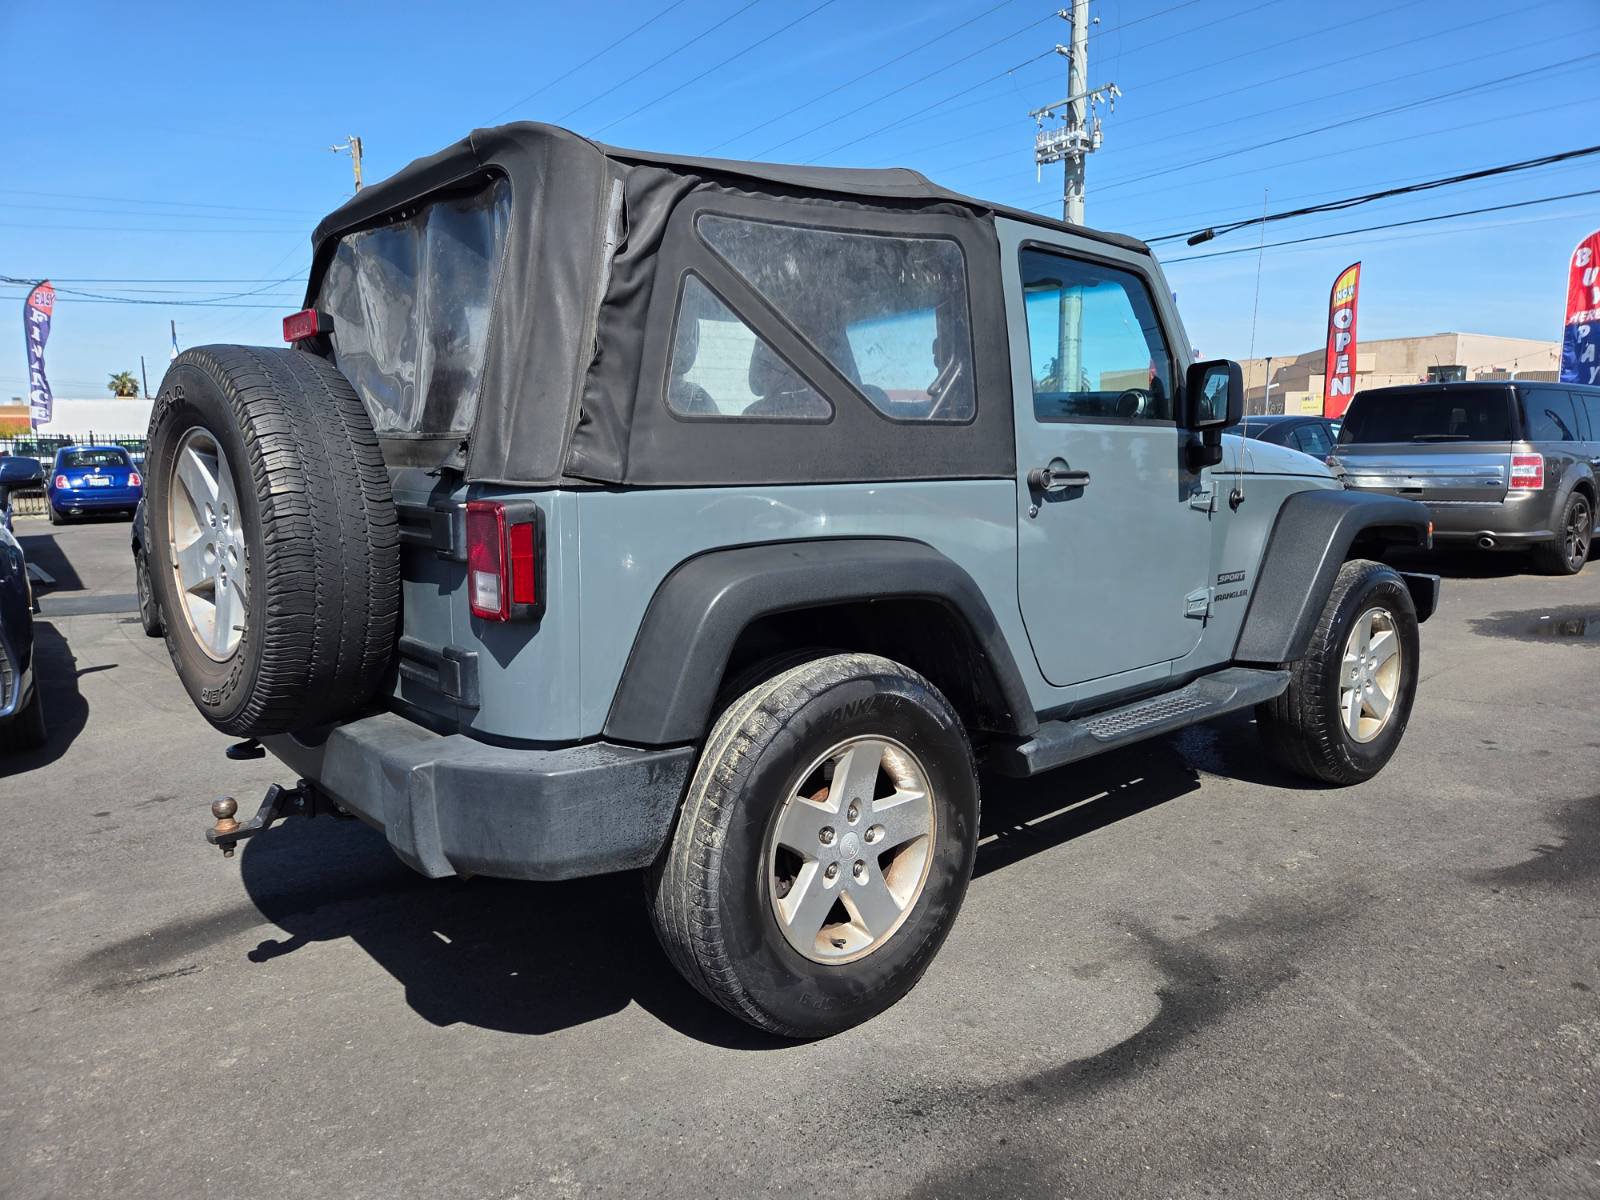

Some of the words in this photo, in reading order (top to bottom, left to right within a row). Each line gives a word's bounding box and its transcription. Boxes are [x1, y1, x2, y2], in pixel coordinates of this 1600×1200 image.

[34, 291, 55, 306] EASY
[1335, 285, 1355, 301] NOW
[1330, 308, 1353, 397] OPEN
[1217, 571, 1246, 584] SPORT
